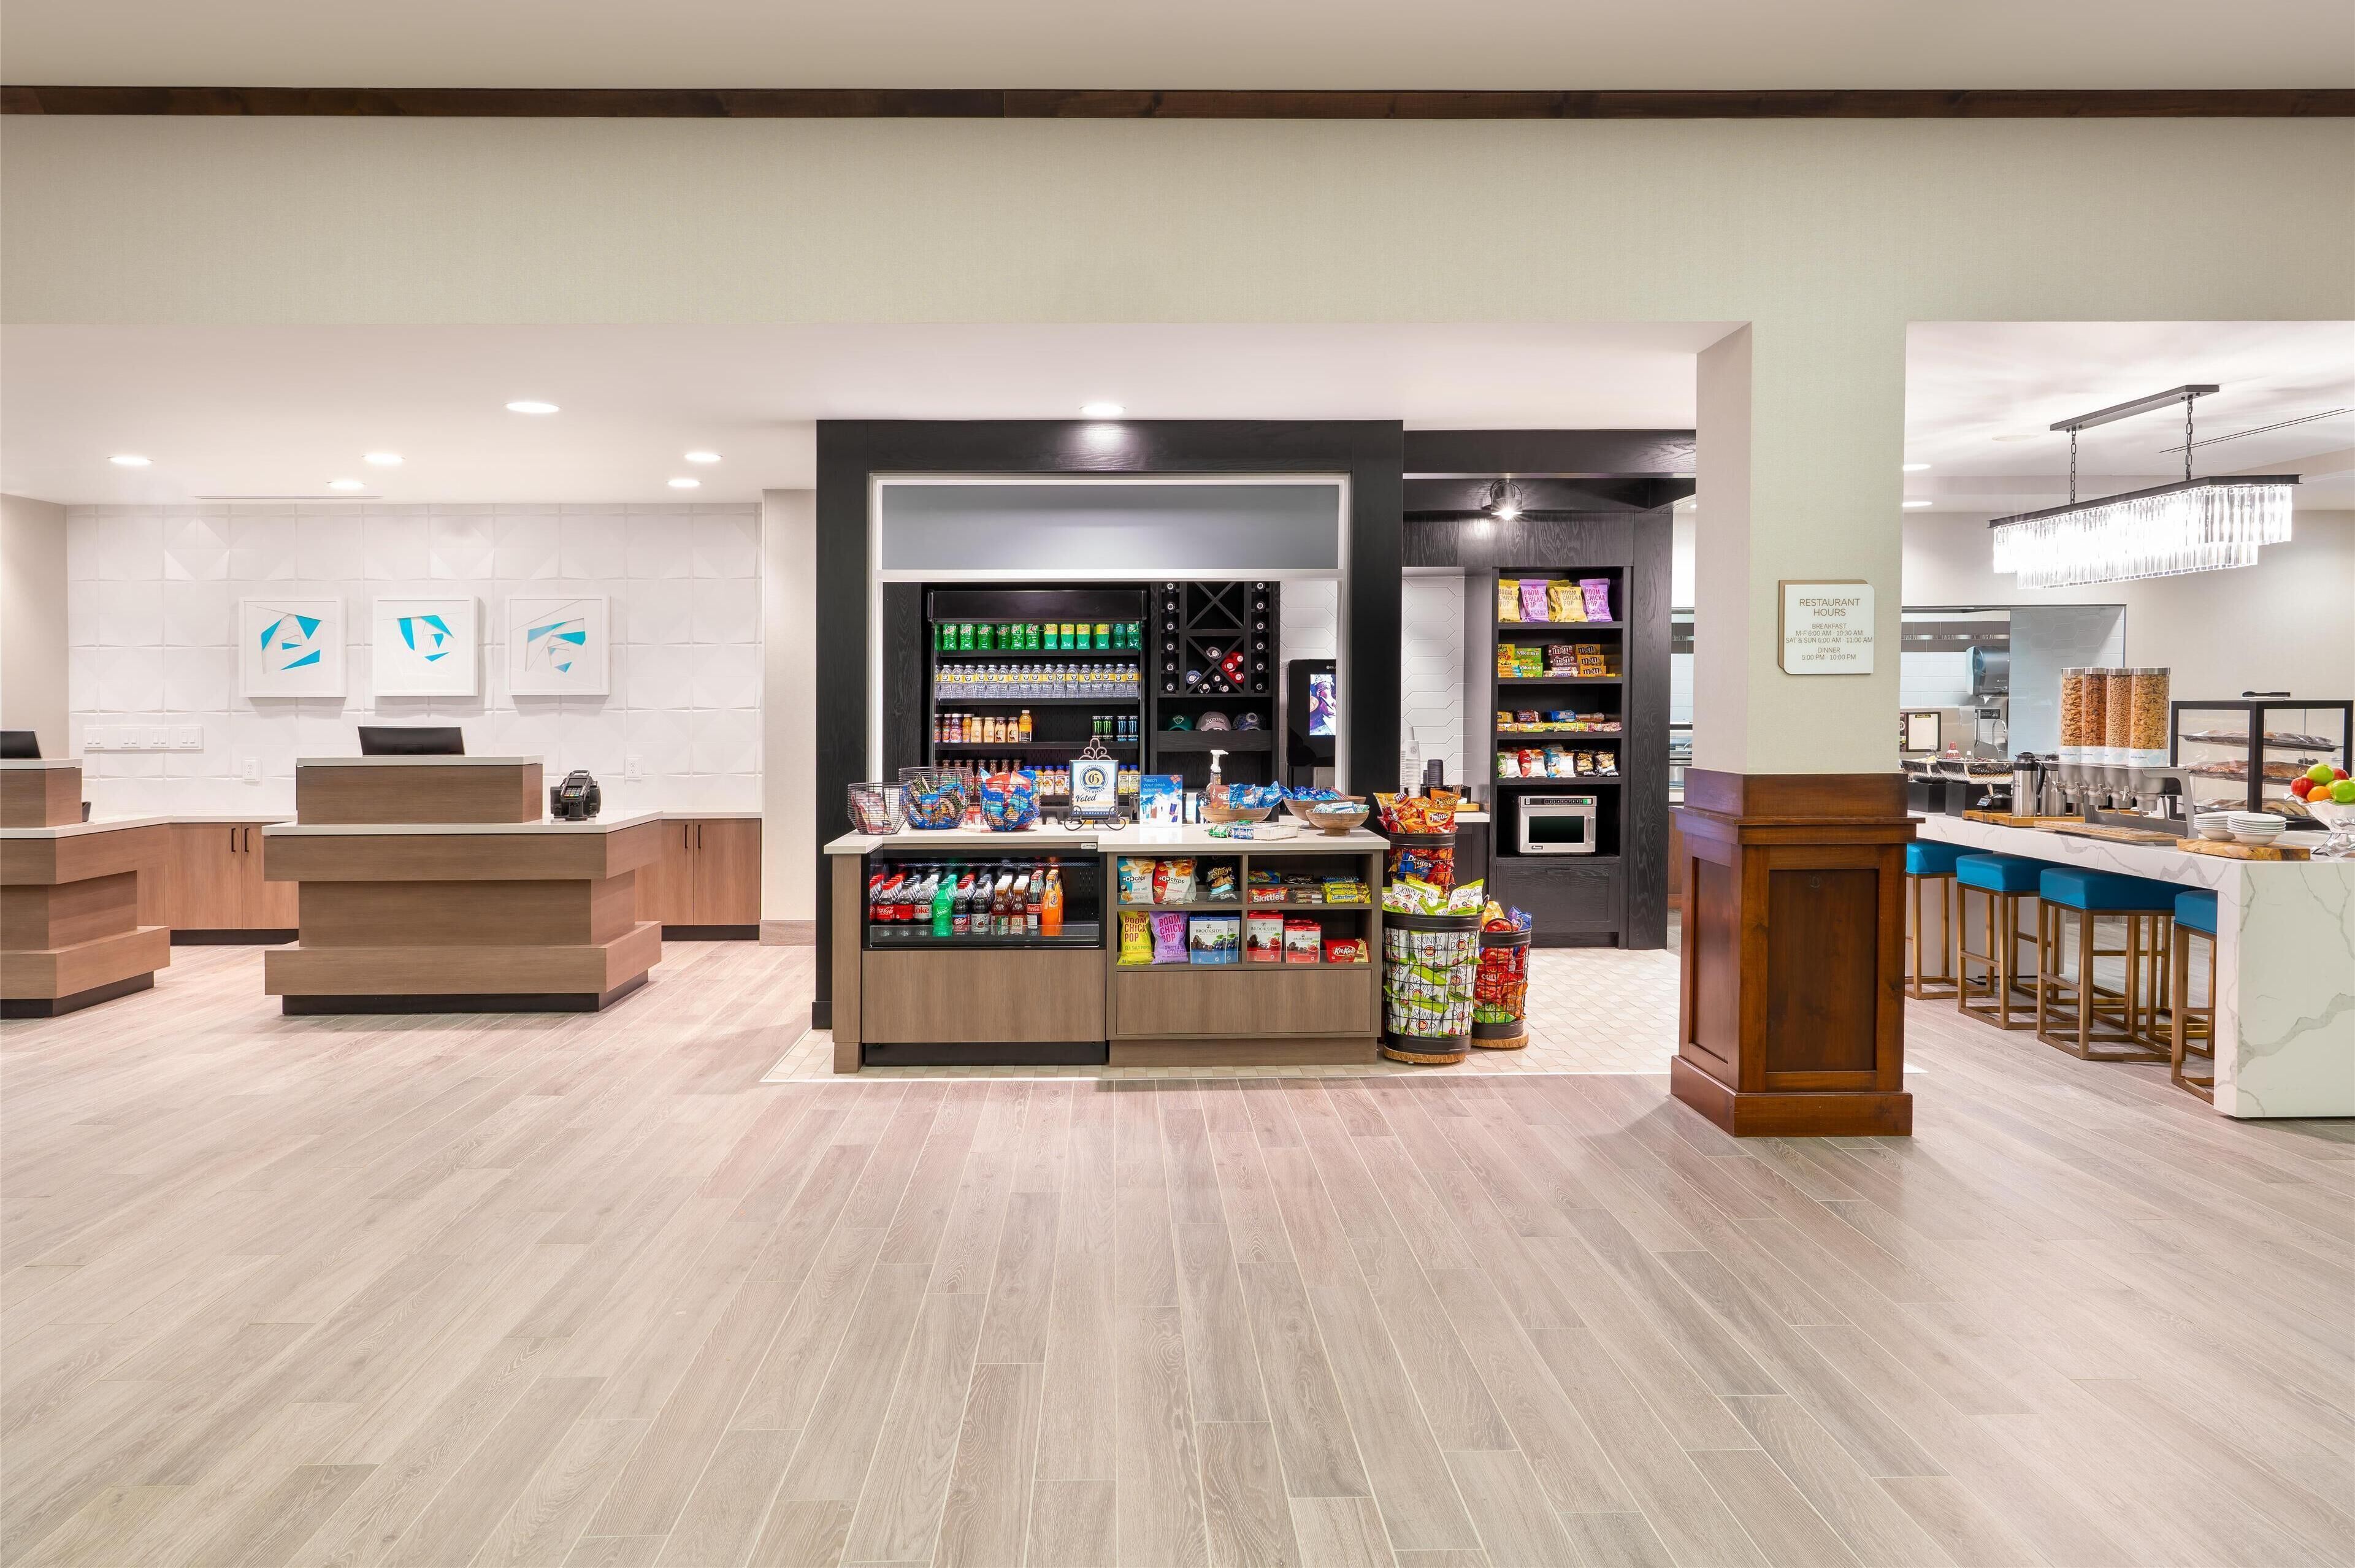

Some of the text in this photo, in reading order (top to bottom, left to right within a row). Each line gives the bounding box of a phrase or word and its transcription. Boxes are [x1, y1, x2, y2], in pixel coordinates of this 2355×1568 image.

[1075, 794, 1097, 802] Voted
[1430, 813, 1448, 822] Fritos
[1211, 866, 1232, 879] Stacy's
[1397, 885, 1420, 898] SKINNY
[1253, 893, 1284, 903] Skittles
[1158, 914, 1181, 927] BOOM
[1160, 924, 1185, 935] CHICKA
[1124, 933, 1139, 943] POP
[1416, 934, 1442, 945] SKINNY
[1412, 976, 1436, 994] SKINNY
[1413, 1008, 1440, 1020] SKINNY
